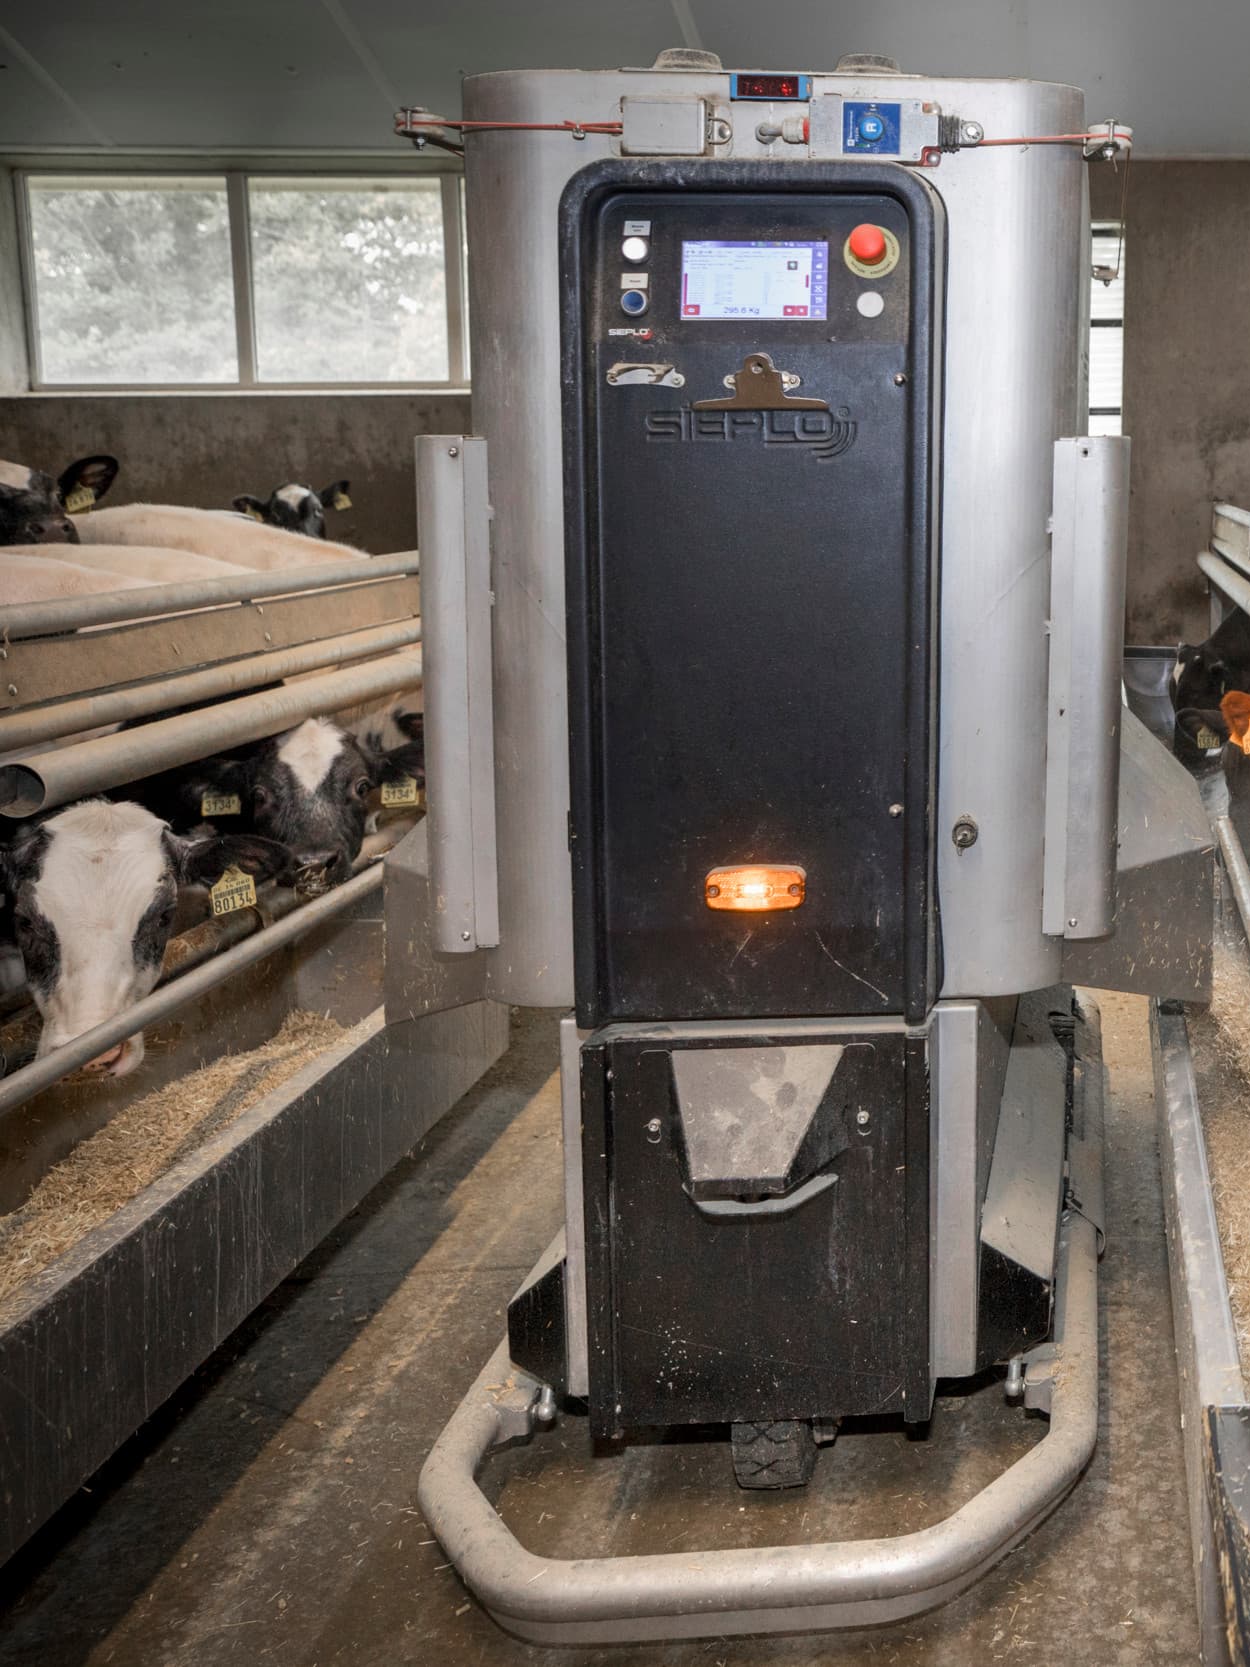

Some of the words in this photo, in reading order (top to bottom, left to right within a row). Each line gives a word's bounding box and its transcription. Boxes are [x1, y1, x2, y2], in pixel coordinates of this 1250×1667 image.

[608, 328, 649, 336] SIEPLO
[645, 406, 834, 448] SIEPLO
[214, 891, 255, 914] 80134
